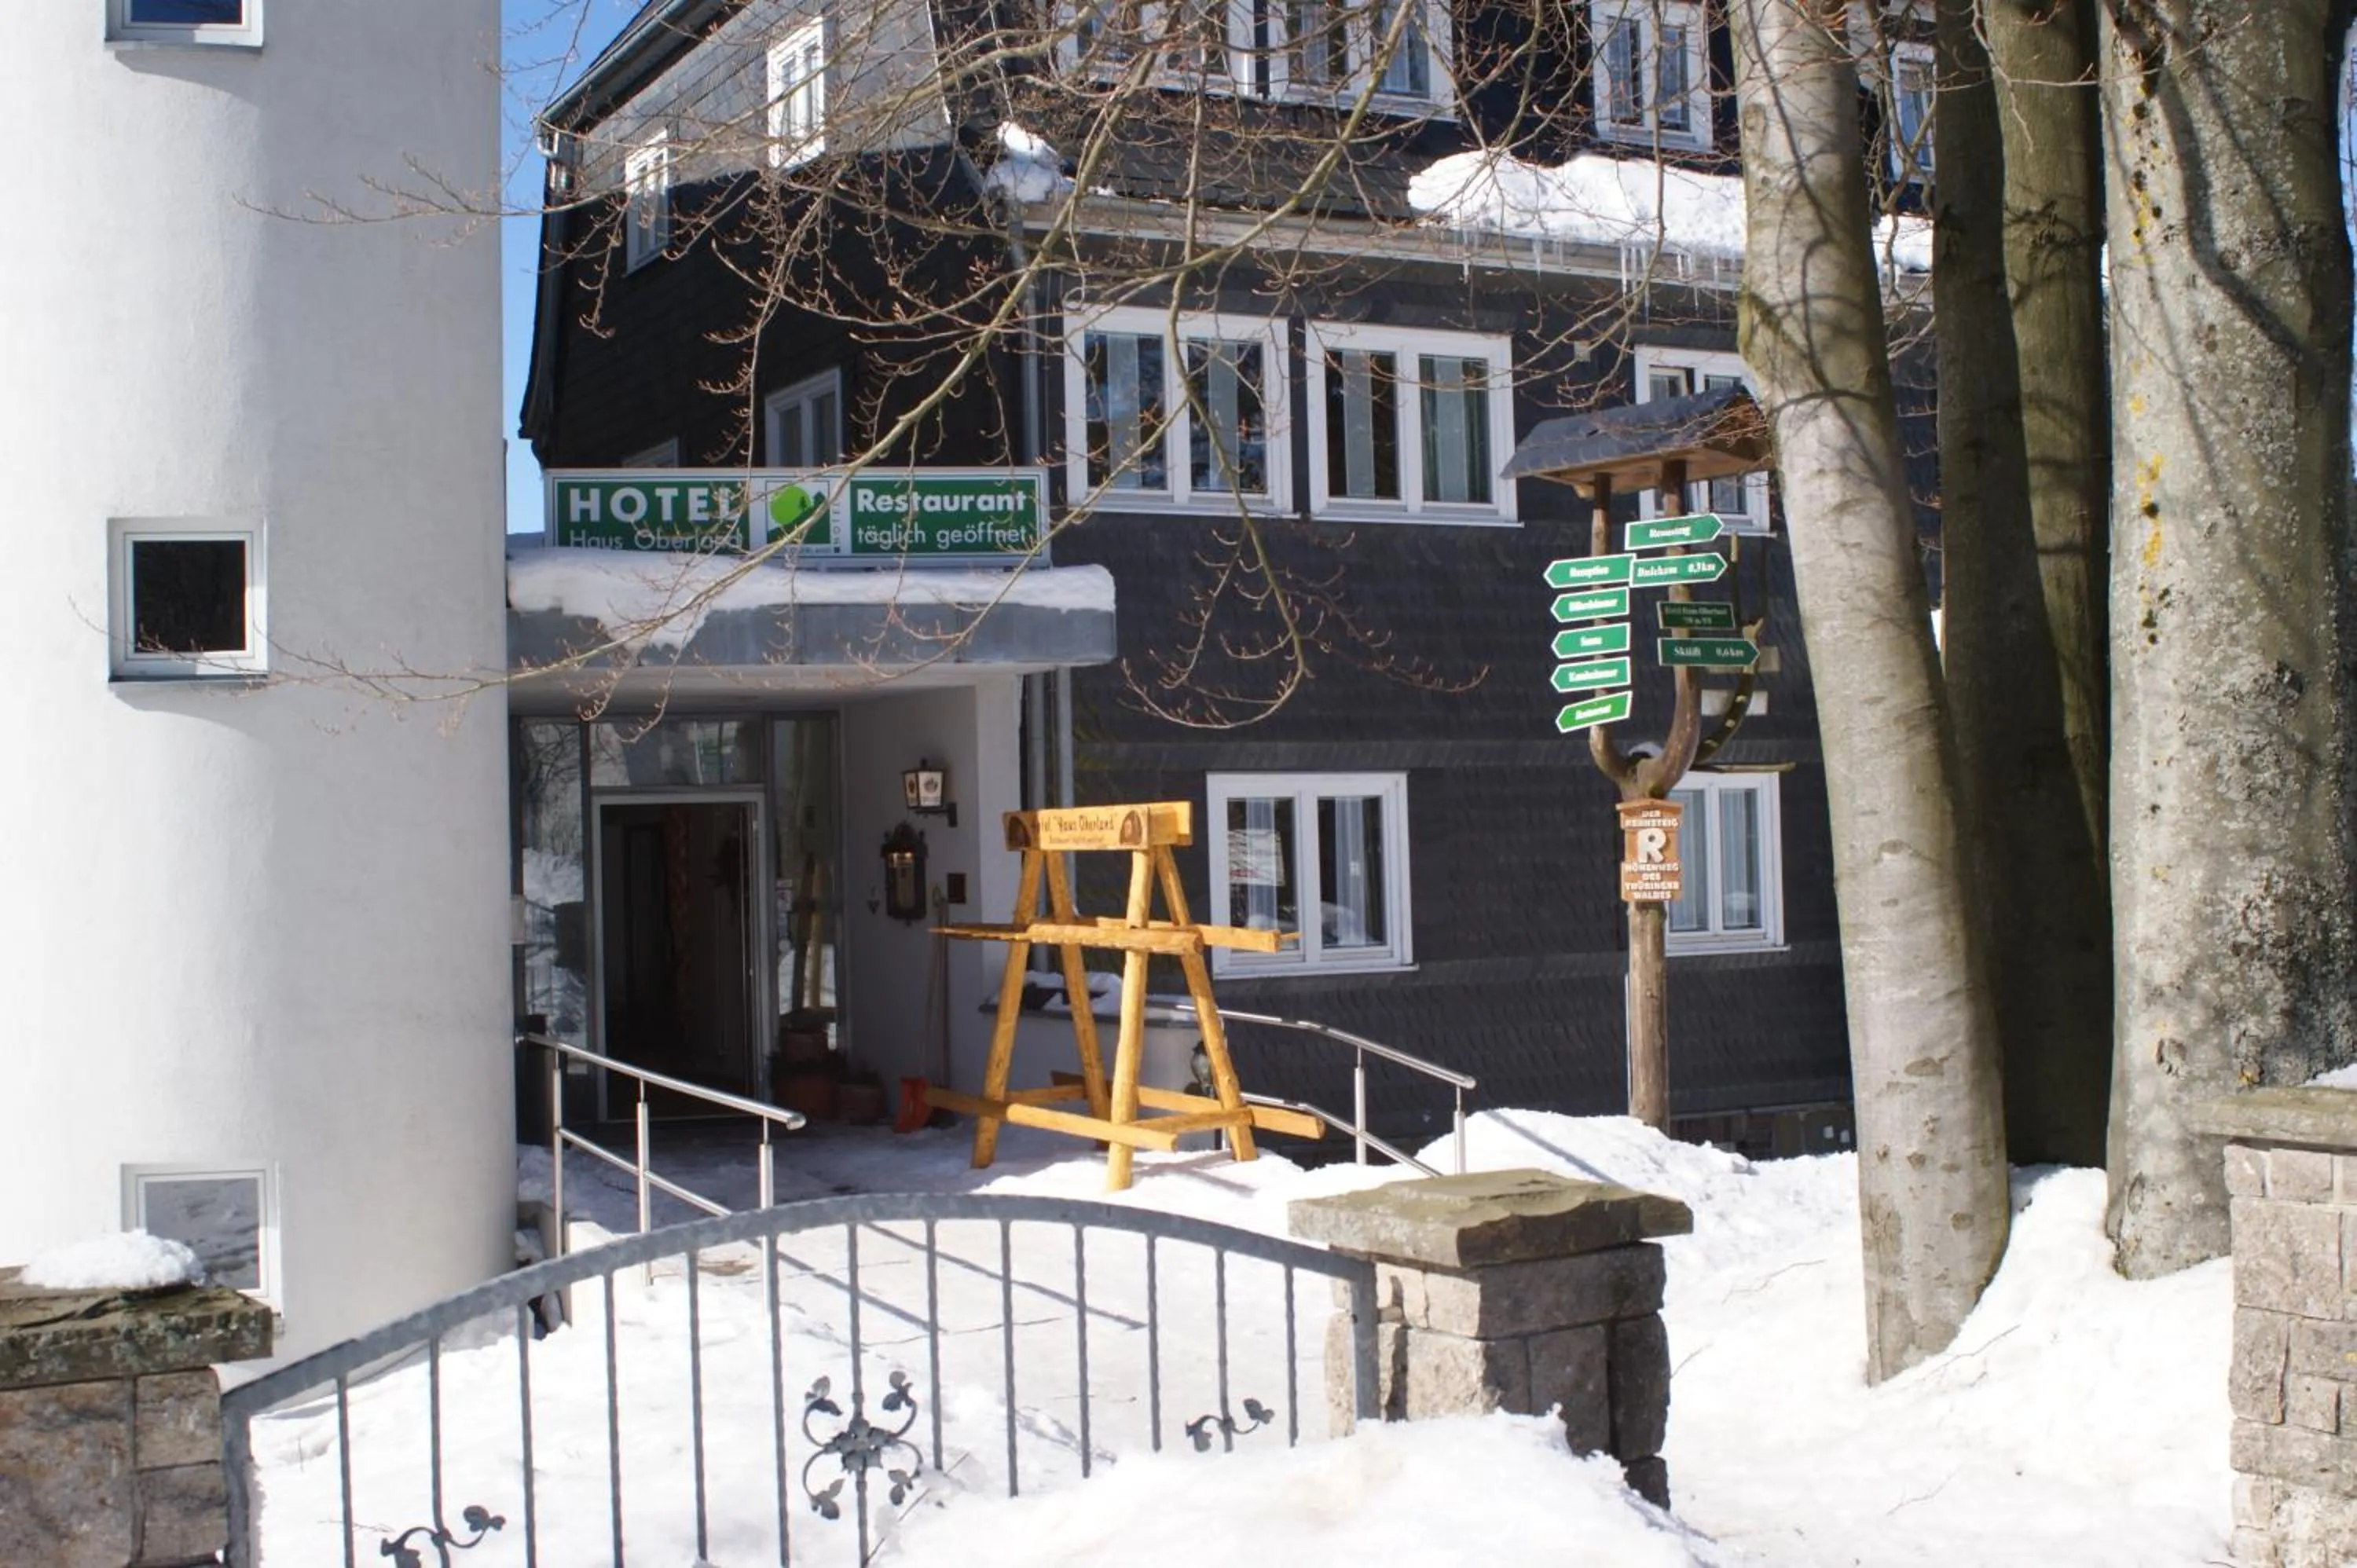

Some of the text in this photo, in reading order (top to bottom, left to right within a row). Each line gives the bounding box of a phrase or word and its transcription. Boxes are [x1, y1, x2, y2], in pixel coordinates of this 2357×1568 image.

[570, 486, 739, 523] HOTEL
[856, 488, 1027, 512] Restaurant
[570, 529, 624, 550] Haus
[857, 522, 1027, 550] täglich geöffnet
[1637, 828, 1667, 863] R
